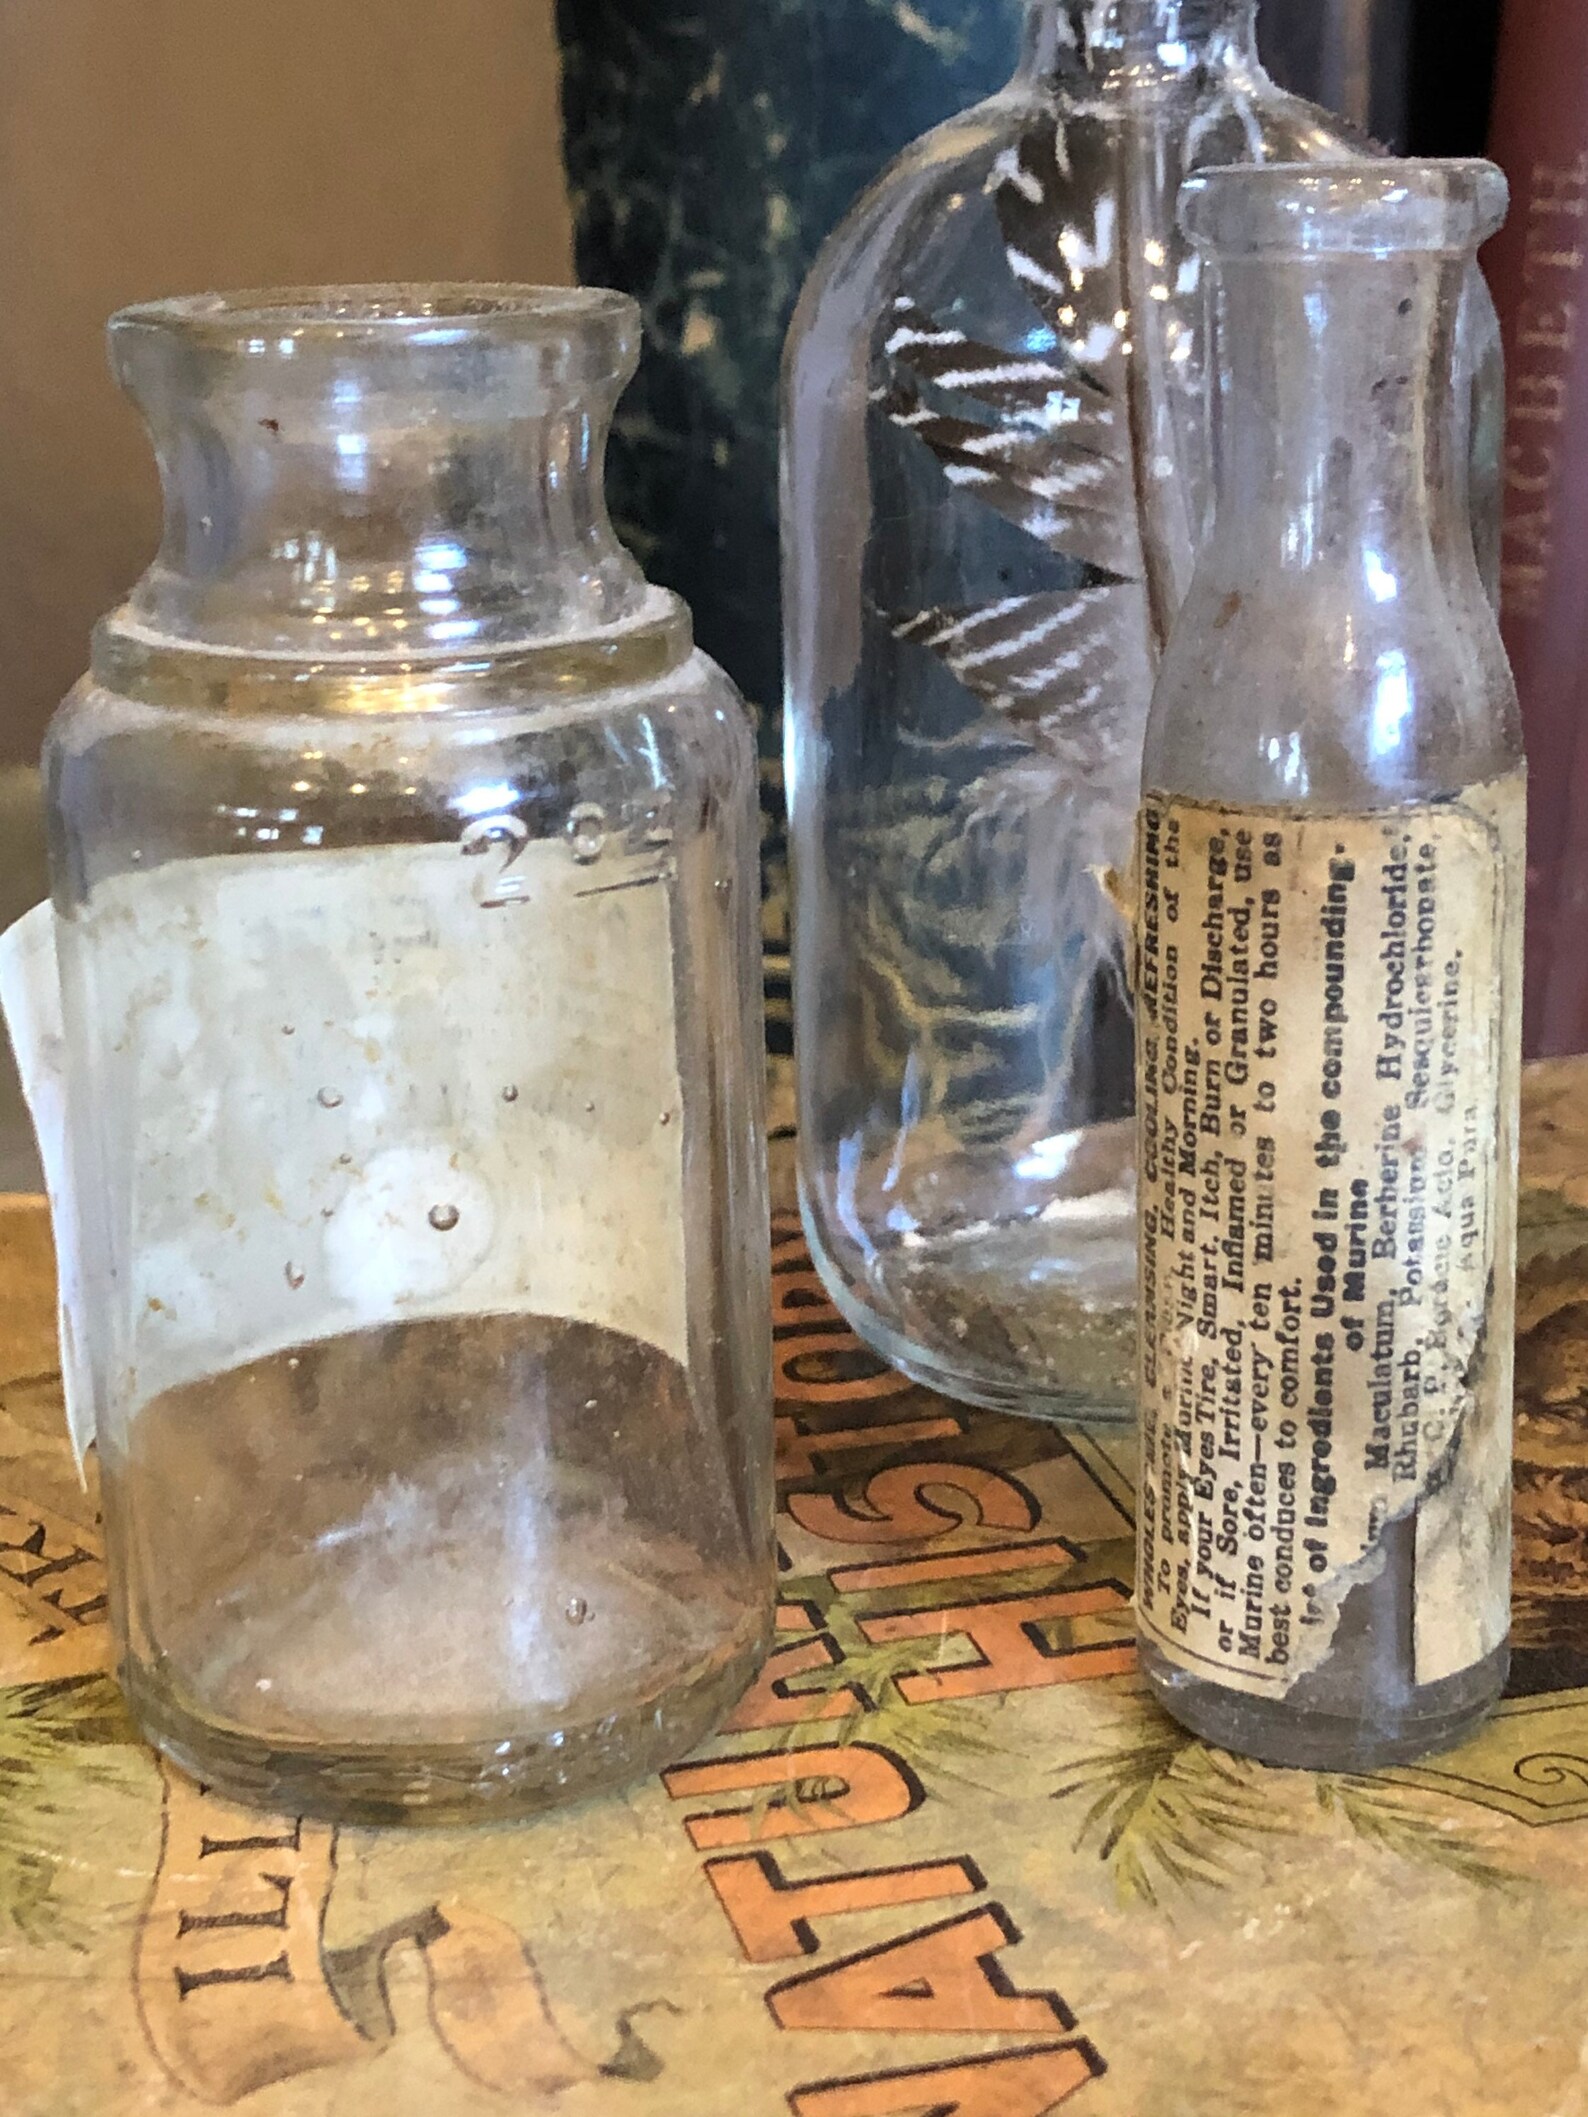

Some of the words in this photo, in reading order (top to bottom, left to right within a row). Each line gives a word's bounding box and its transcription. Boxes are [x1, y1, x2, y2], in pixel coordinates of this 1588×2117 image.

[1500, 152, 1588, 618] MACBETH
[460, 814, 531, 911] 2
[1164, 818, 1179, 868] the
[1233, 829, 1252, 882] use
[1262, 832, 1281, 867] as
[1164, 886, 1179, 922] of
[1200, 828, 1230, 1001] Discharge,
[1254, 888, 1281, 980] hours
[1161, 945, 1178, 1095] Condition
[1224, 897, 1255, 1085] Granulated,
[1204, 1012, 1222, 1046] or
[1254, 998, 1278, 1058] two
[1179, 1038, 1200, 1177] Morning.
[1200, 1059, 1221, 1136] Burn
[1230, 1103, 1246, 1137] or
[1253, 1081, 1275, 1112] to
[1314, 1109, 1341, 1168] the
[1160, 1116, 1178, 1241] Healthy
[1200, 1151, 1222, 1221] Itch,
[1249, 1136, 1274, 1262] minutes
[1312, 1188, 1339, 1220] in
[1371, 1104, 1401, 1260] Berberine
[1178, 1189, 1195, 1244] and
[1221, 1158, 1246, 1293] Inflamed
[1342, 1178, 1368, 1302] Murine
[1249, 1283, 1272, 1331] ten
[1310, 1232, 1338, 1318] Used
[1275, 1277, 1302, 1408] comfort.
[1340, 1315, 1364, 1351] of
[1195, 1358, 1218, 1423] Tire,
[1218, 1320, 1246, 1461] Irritated,
[1193, 1432, 1216, 1500] Eyes
[1274, 1419, 1297, 1450] to
[1304, 1332, 1335, 1527] Ingredients
[1143, 1410, 1157, 1610] WHOLESME,
[1161, 1423, 1173, 1545] promote
[1175, 1467, 1192, 1546] apply
[1216, 1481, 1243, 1555] Sore,
[1196, 1511, 1213, 1579] your
[1270, 1461, 1296, 1593] conduces
[1302, 1538, 1328, 1573] of
[1157, 1559, 1171, 1593] To
[1171, 1560, 1191, 1633] Eyes,
[1191, 1591, 1211, 1618] If
[1215, 1573, 1236, 1600] if
[1239, 1555, 1264, 1659] Murine
[1218, 1619, 1233, 1653] or
[1266, 1604, 1291, 1665] best
[173, 1783, 301, 2004] ILL
